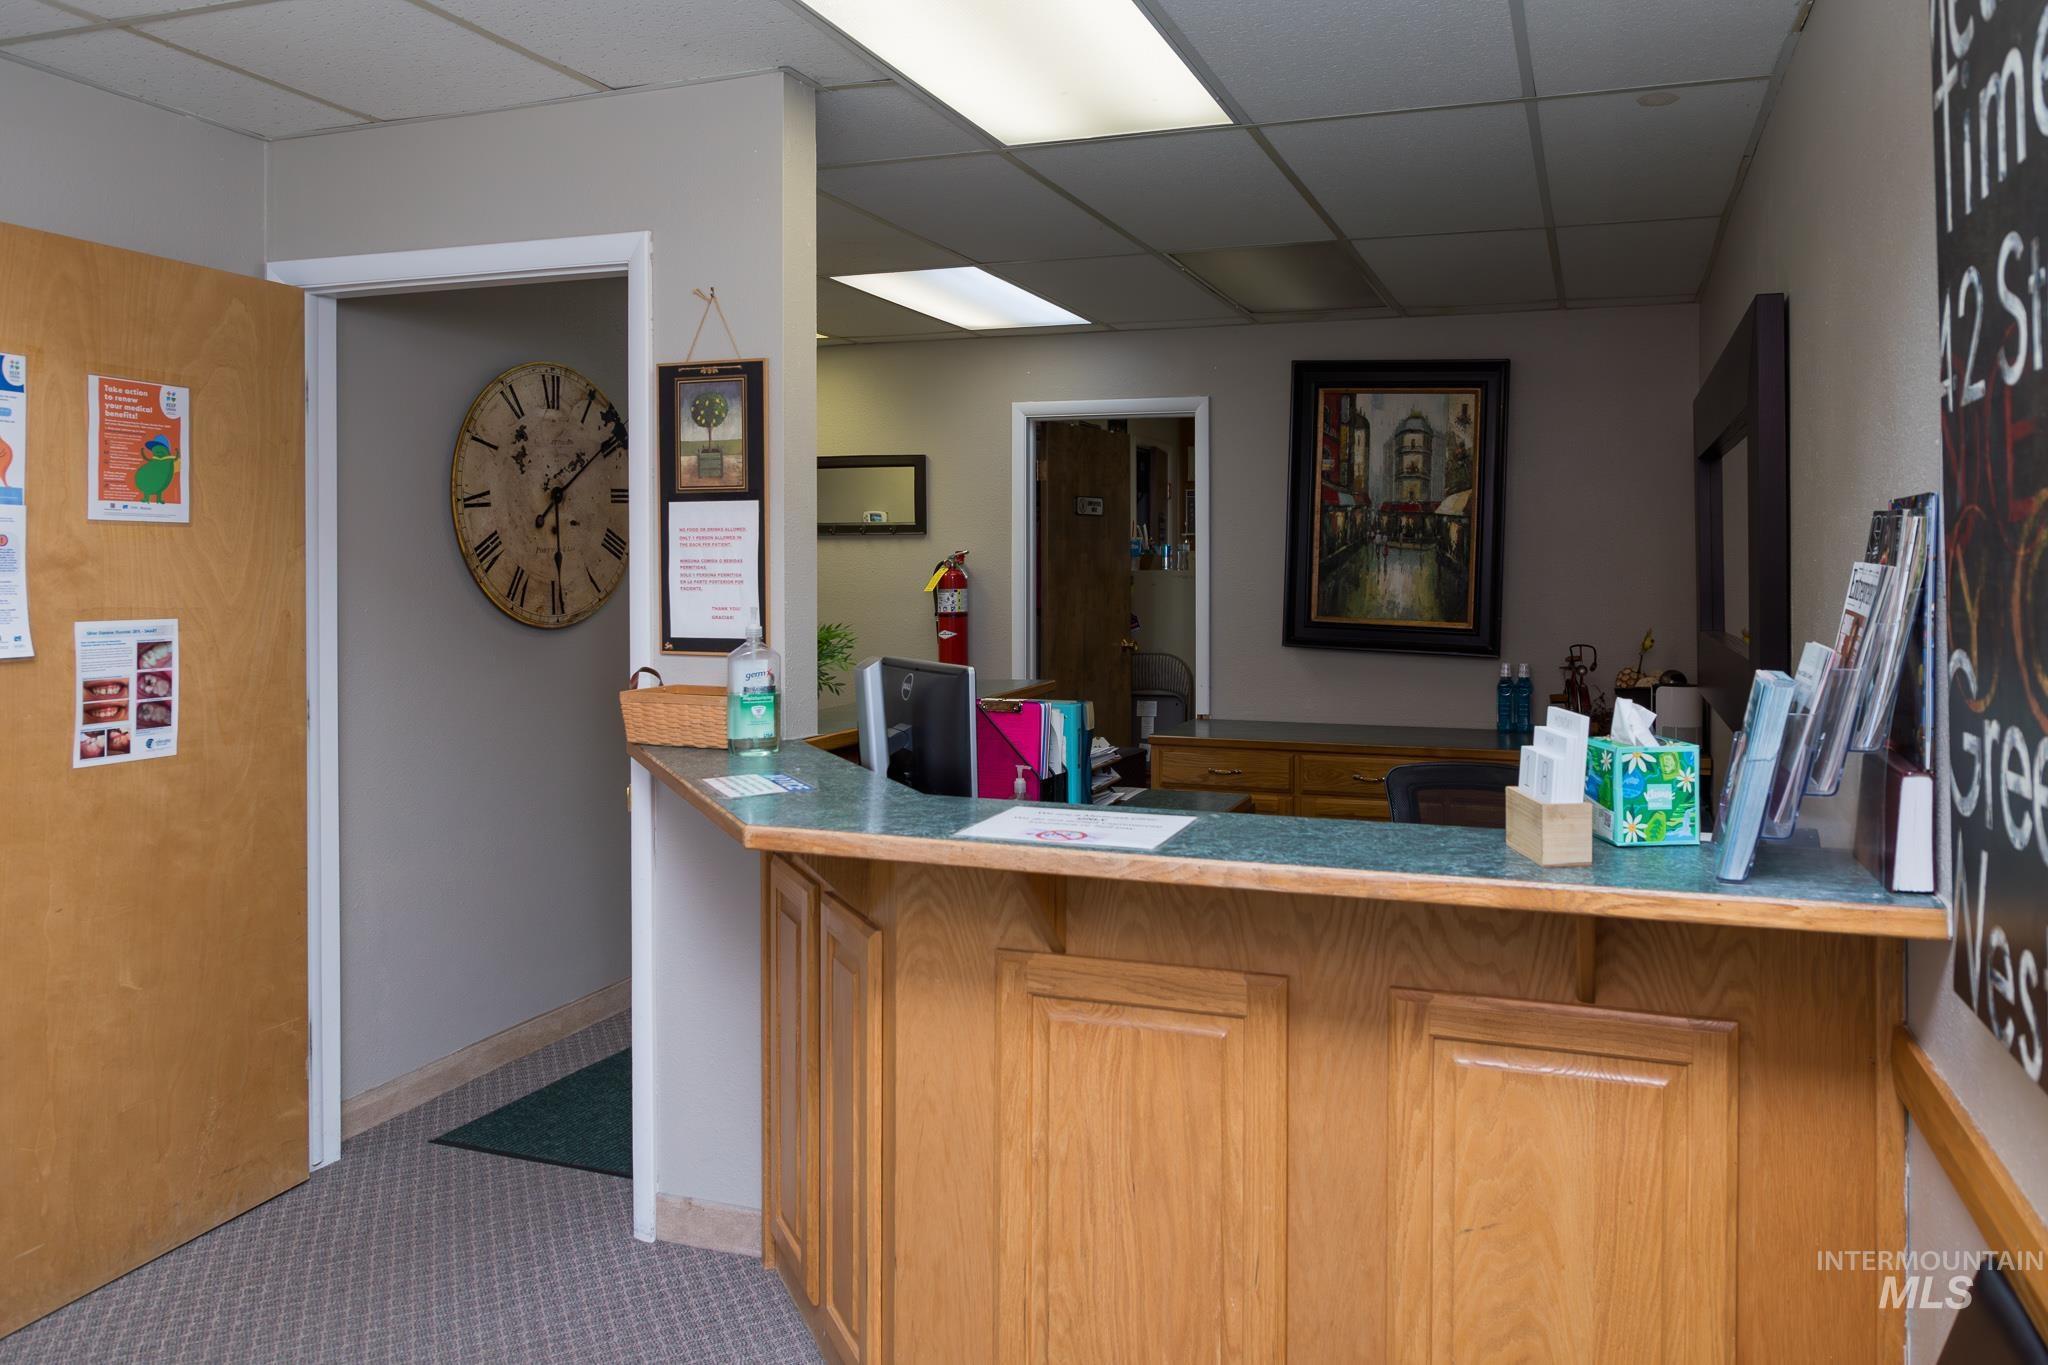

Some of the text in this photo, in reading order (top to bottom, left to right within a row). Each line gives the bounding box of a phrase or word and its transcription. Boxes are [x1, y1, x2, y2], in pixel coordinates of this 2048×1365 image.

[104, 385, 149, 397] Take action
[124, 404, 153, 413] medical
[104, 410, 138, 420] benefits!
